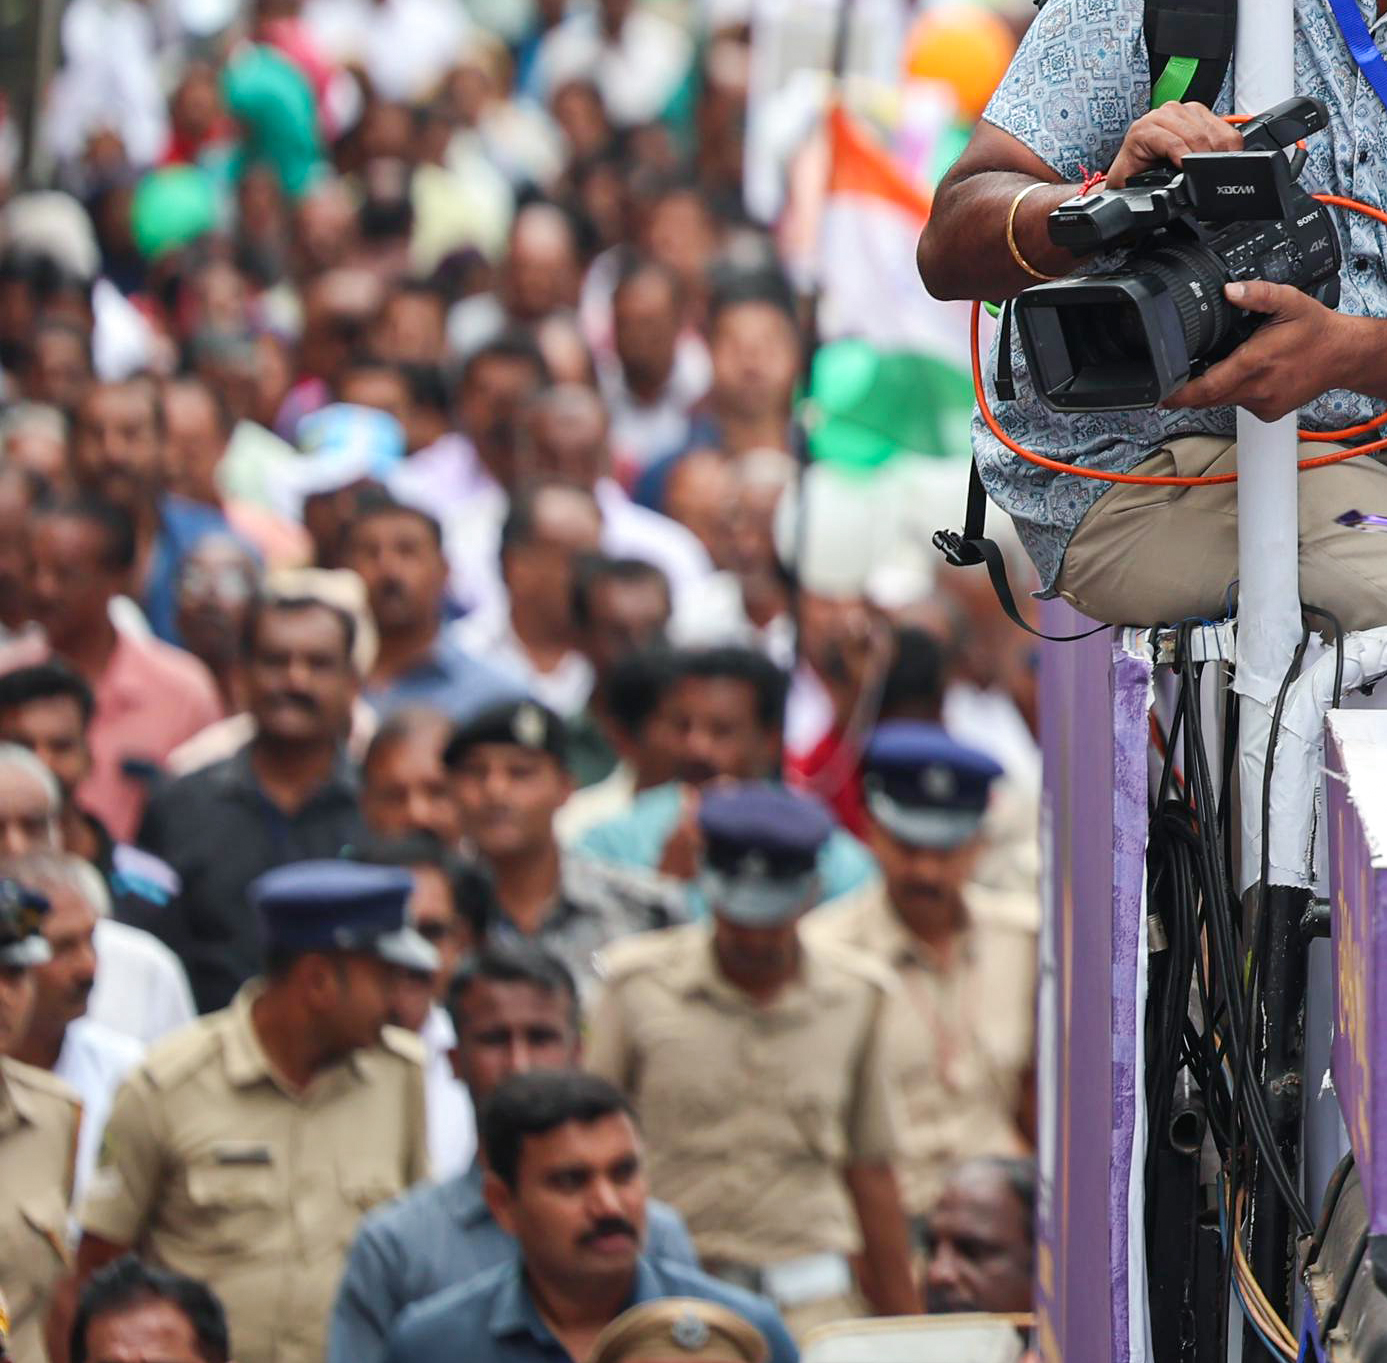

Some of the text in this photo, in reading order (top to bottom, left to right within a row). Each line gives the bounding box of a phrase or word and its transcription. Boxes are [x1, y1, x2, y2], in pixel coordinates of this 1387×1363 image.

[1216, 185, 1256, 195] XDCAM
[1296, 210, 1319, 227] SONY
[1310, 237, 1329, 253] 4K
